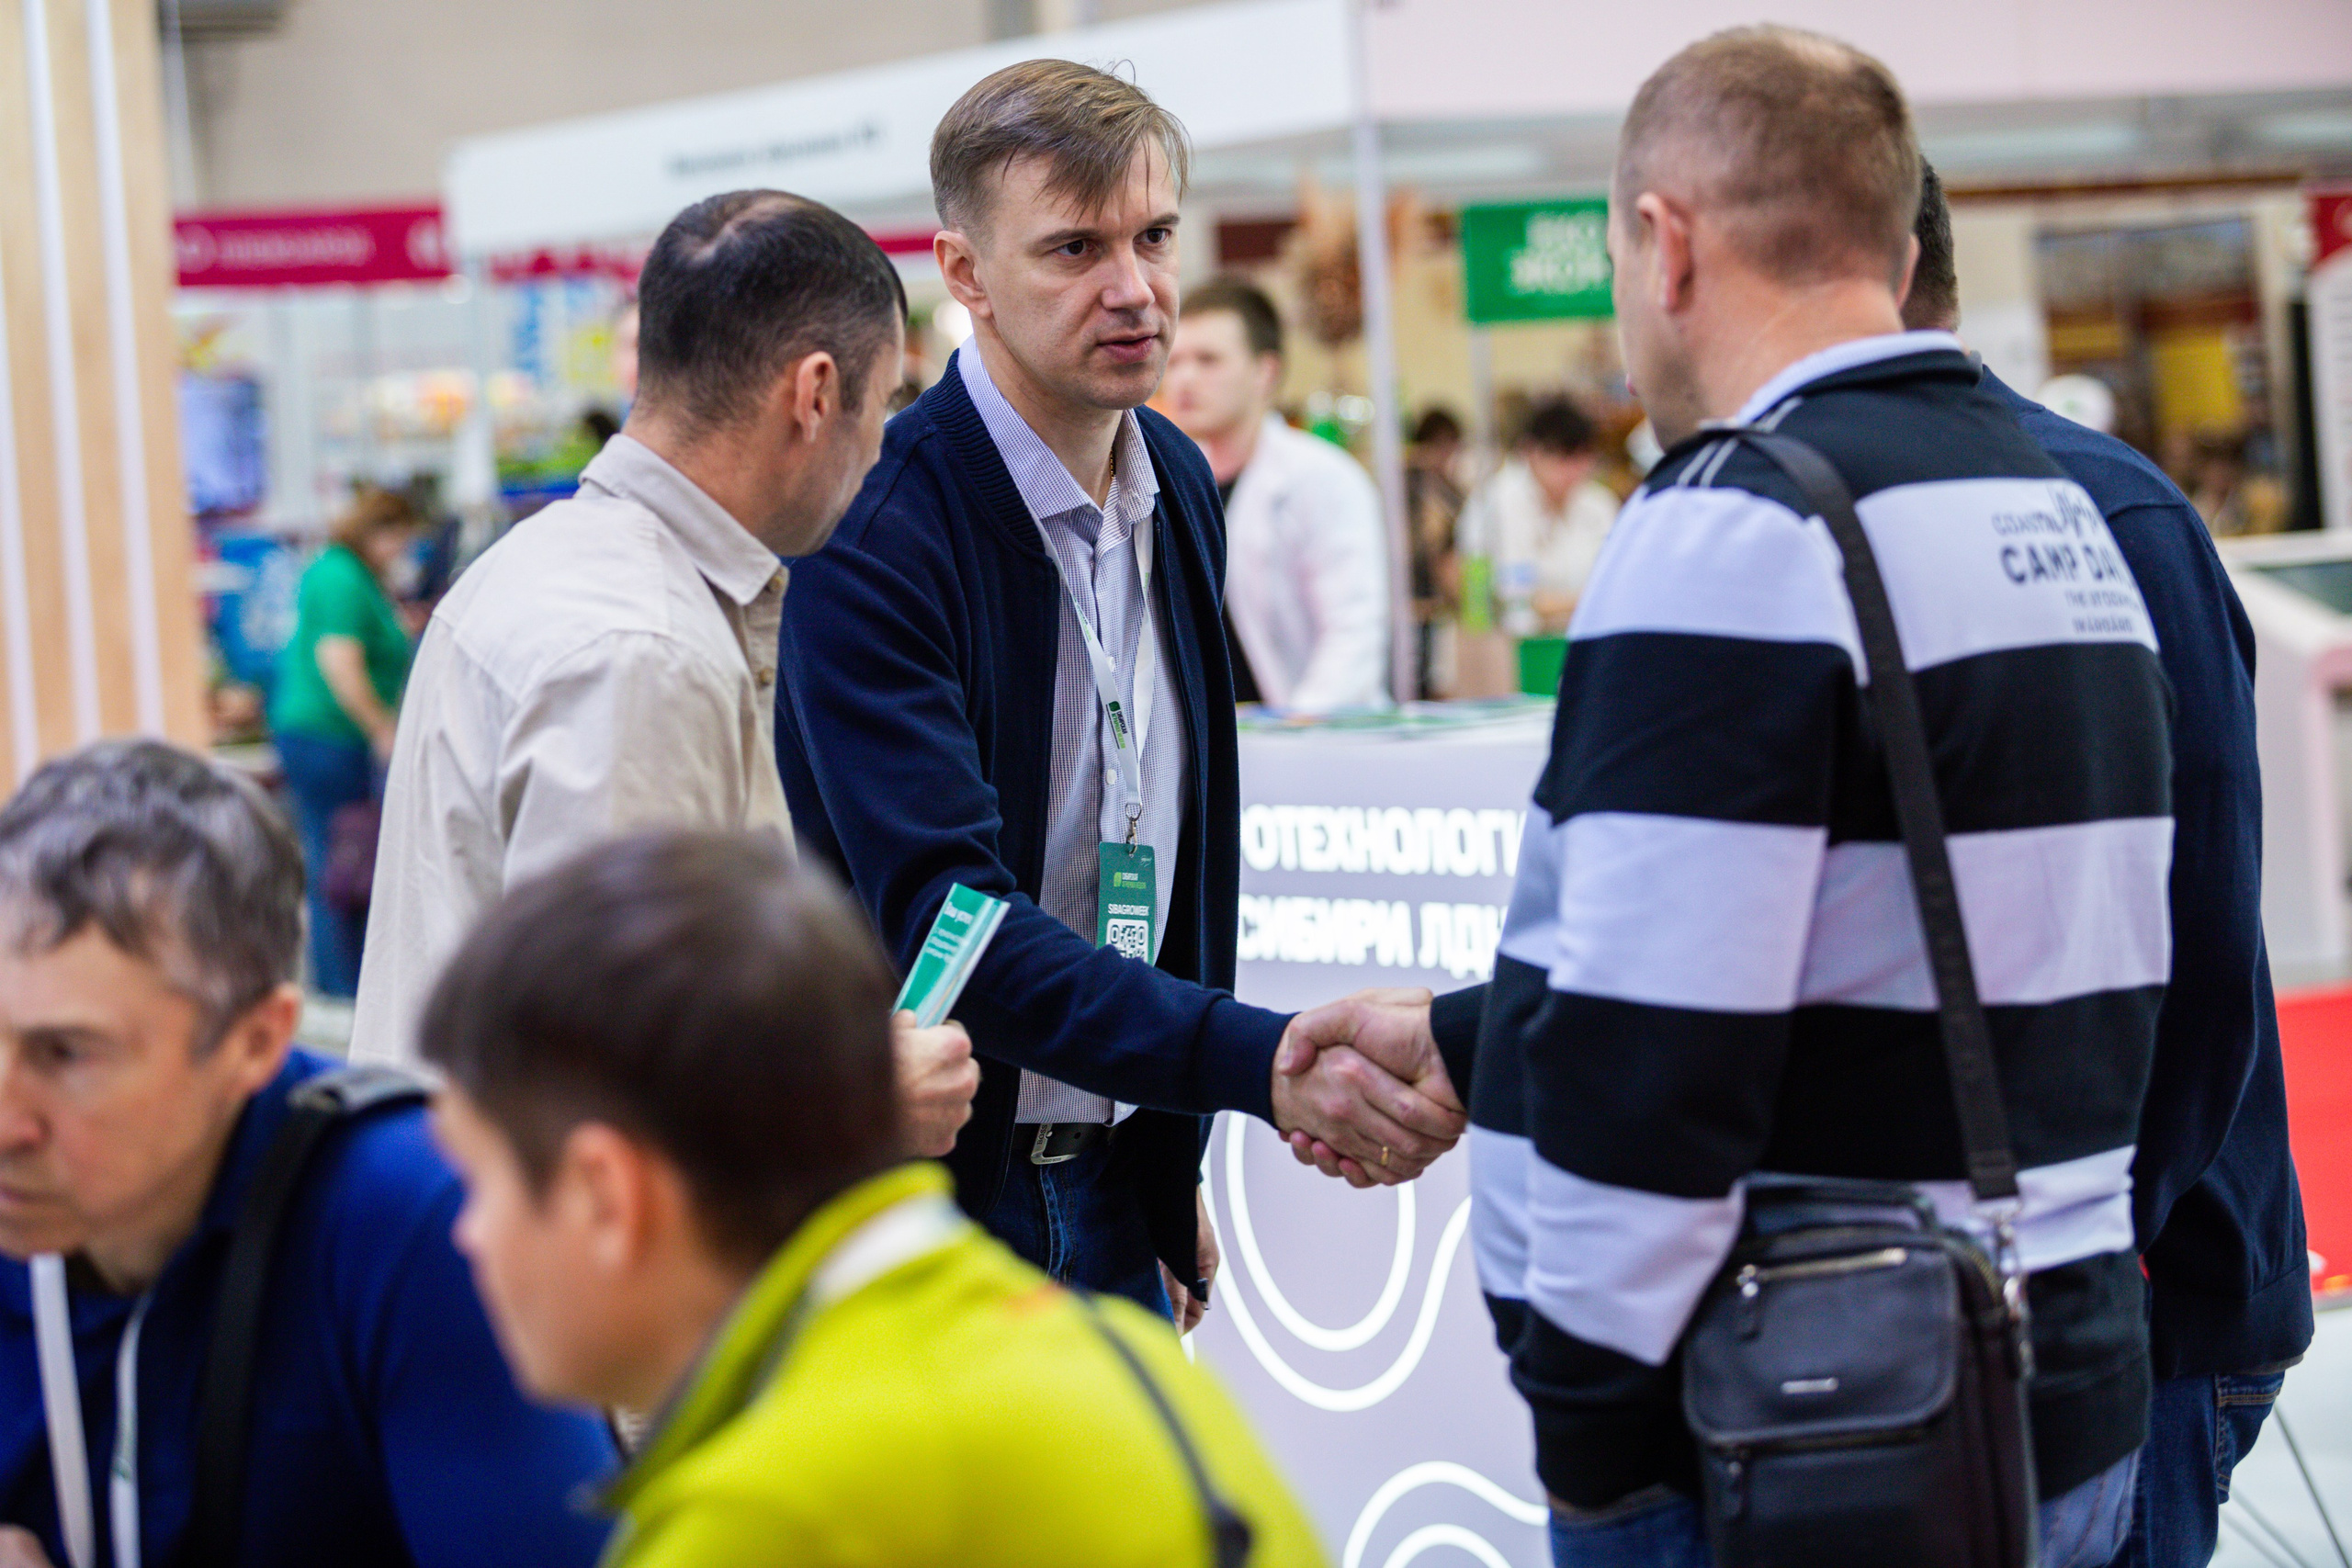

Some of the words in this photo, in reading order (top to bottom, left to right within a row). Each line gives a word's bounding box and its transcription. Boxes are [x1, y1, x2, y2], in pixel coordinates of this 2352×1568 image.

[2000, 545, 2078, 585] CAMP
[1239, 804, 1527, 876] ОТЕХНОЛОГИ
[1238, 894, 1415, 968] СИБИРИ
